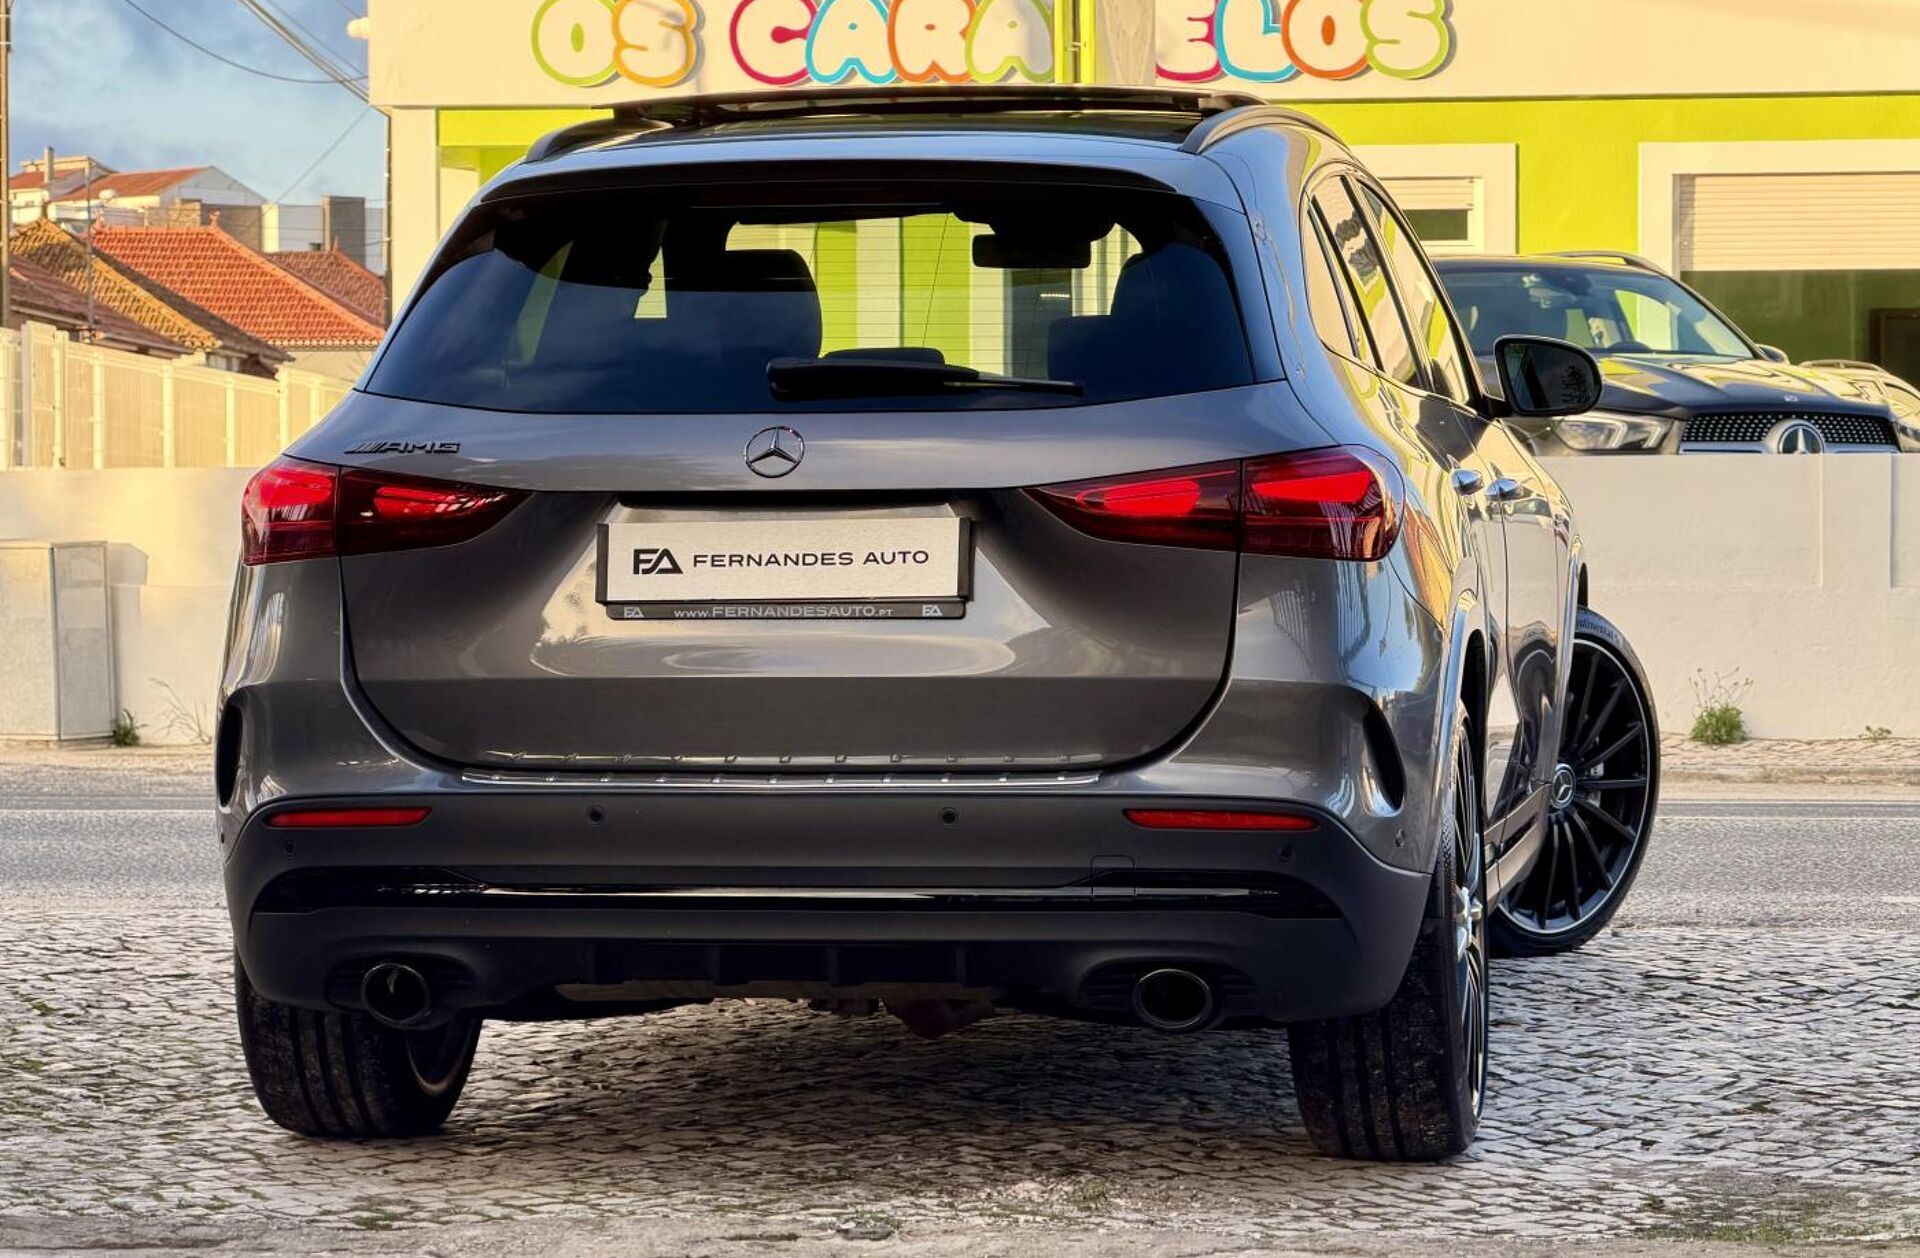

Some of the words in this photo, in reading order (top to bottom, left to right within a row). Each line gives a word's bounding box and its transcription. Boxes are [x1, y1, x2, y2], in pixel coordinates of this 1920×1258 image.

[531, 0, 697, 87] OS
[729, 0, 1450, 85] CARAELOS
[693, 552, 854, 568] FERNANDES
[863, 550, 929, 566] AUTO
